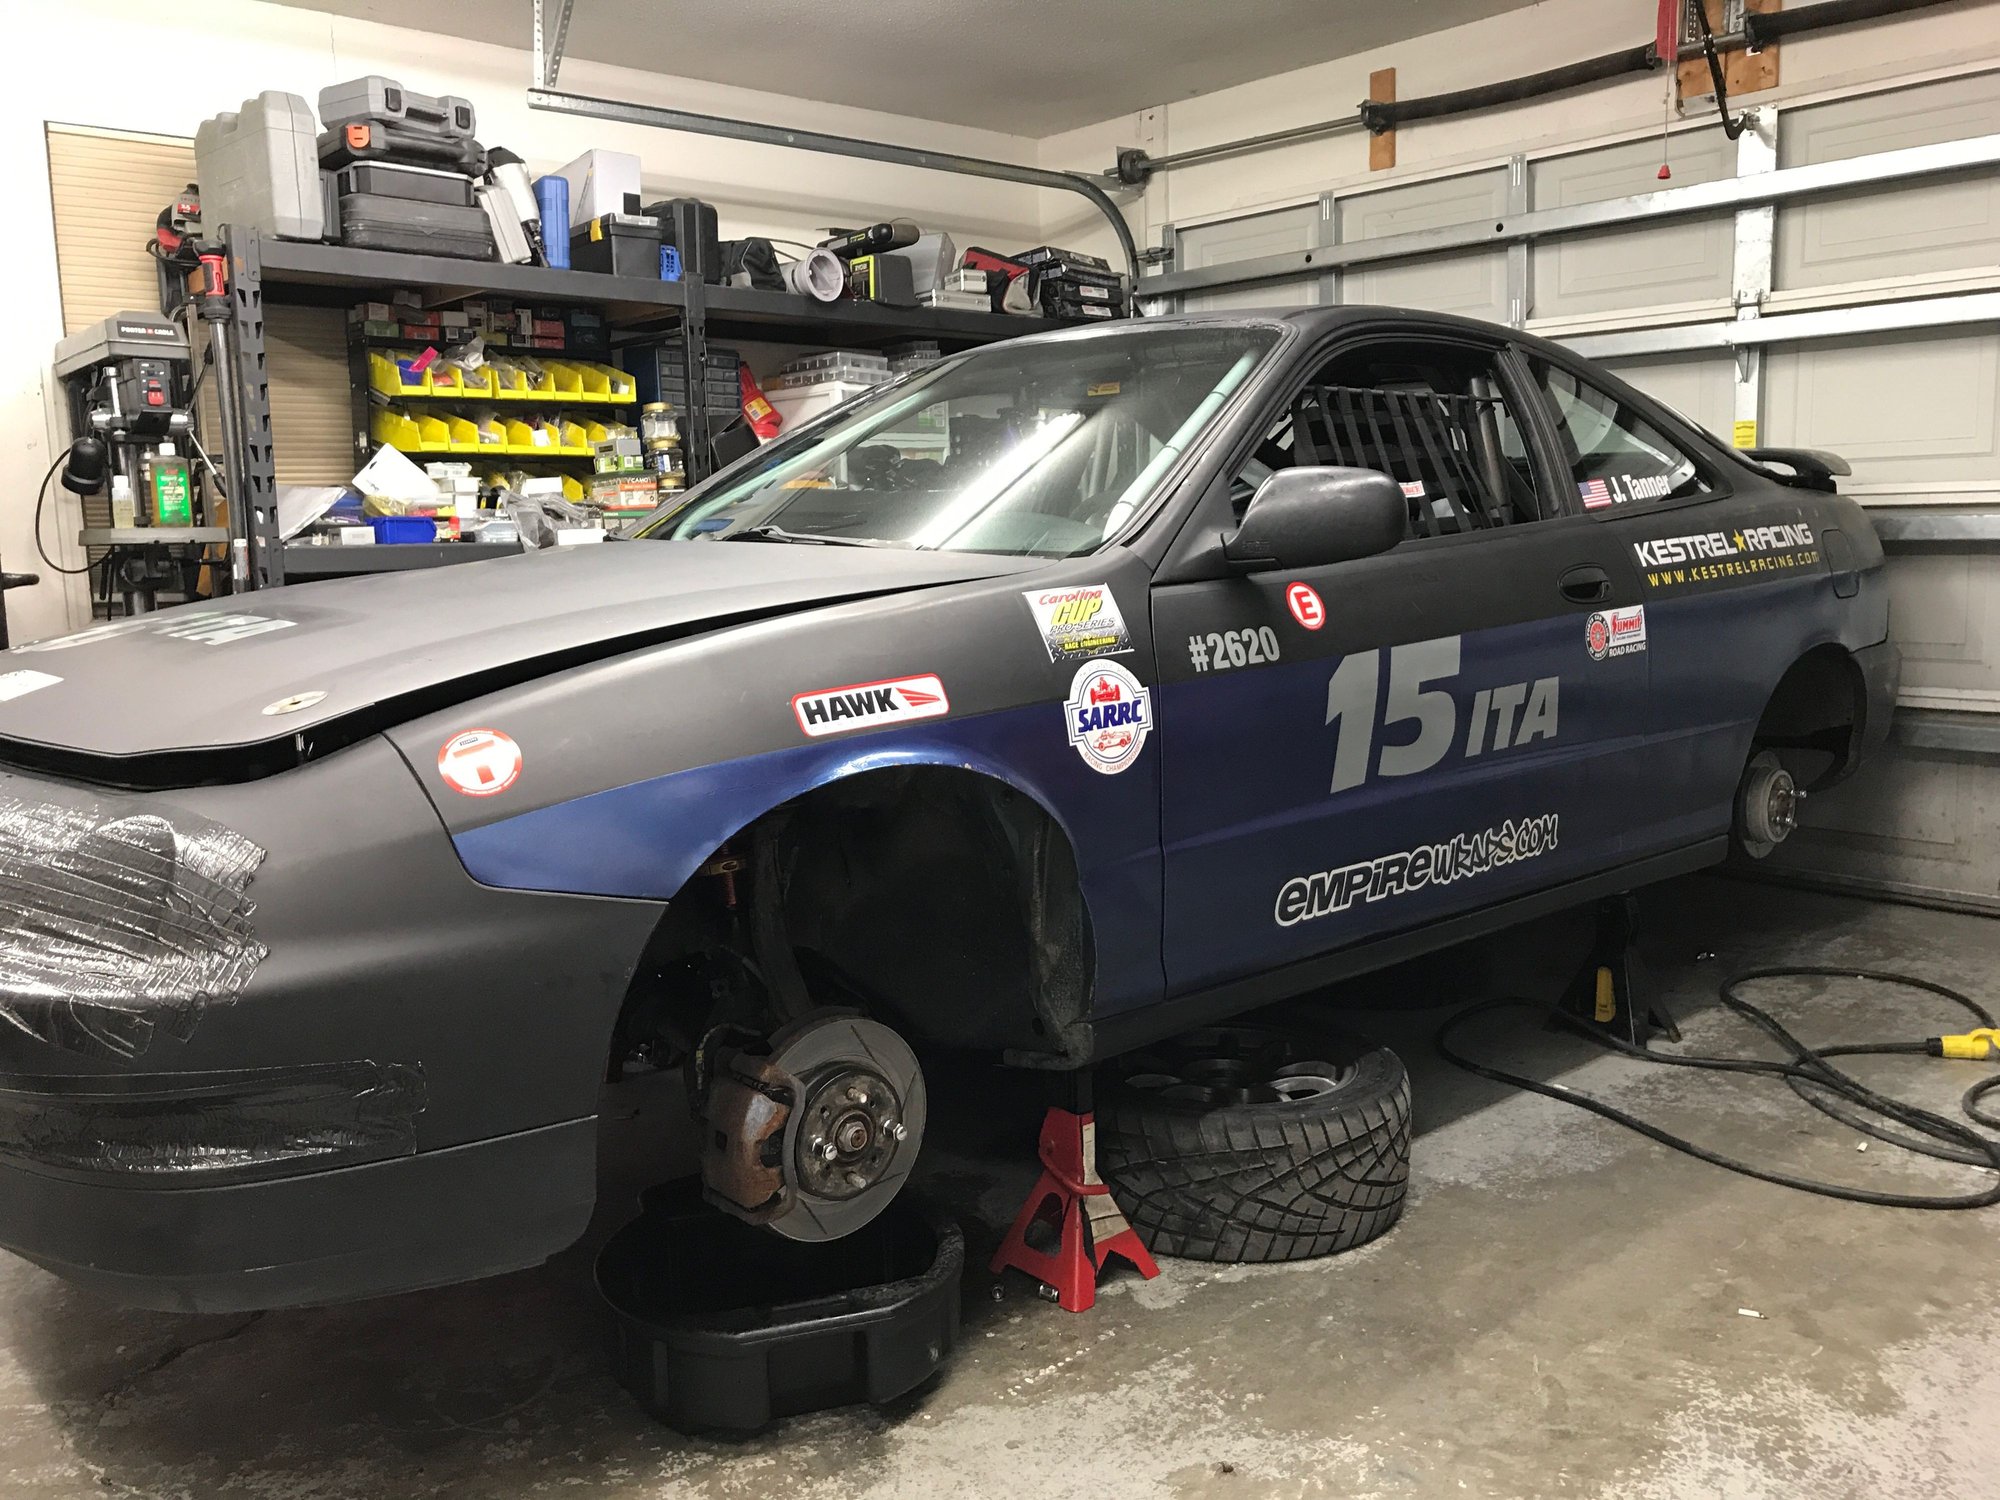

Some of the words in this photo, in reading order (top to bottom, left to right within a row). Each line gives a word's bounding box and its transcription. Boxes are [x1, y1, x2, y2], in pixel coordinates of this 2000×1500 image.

[1610, 476, 1628, 504] J.
[1621, 474, 1672, 500] Tanner
[1633, 531, 1739, 568] KESTREL
[1742, 522, 1814, 552] RACING
[1039, 588, 1103, 606] Carolina
[1050, 599, 1104, 626] CUP
[1293, 590, 1318, 620] E
[1064, 641, 1079, 651] RACE
[1188, 625, 1281, 673] #2620
[1609, 646, 1625, 657] ROAD
[1625, 642, 1647, 654] RACING
[801, 687, 900, 725] HAWK
[1078, 698, 1143, 734] SARRC
[1325, 634, 1462, 794] 15
[1465, 676, 1559, 758] ITA
[1083, 751, 1103, 771] RACING
[1106, 740, 1143, 773] CHAMPIONSHIPS
